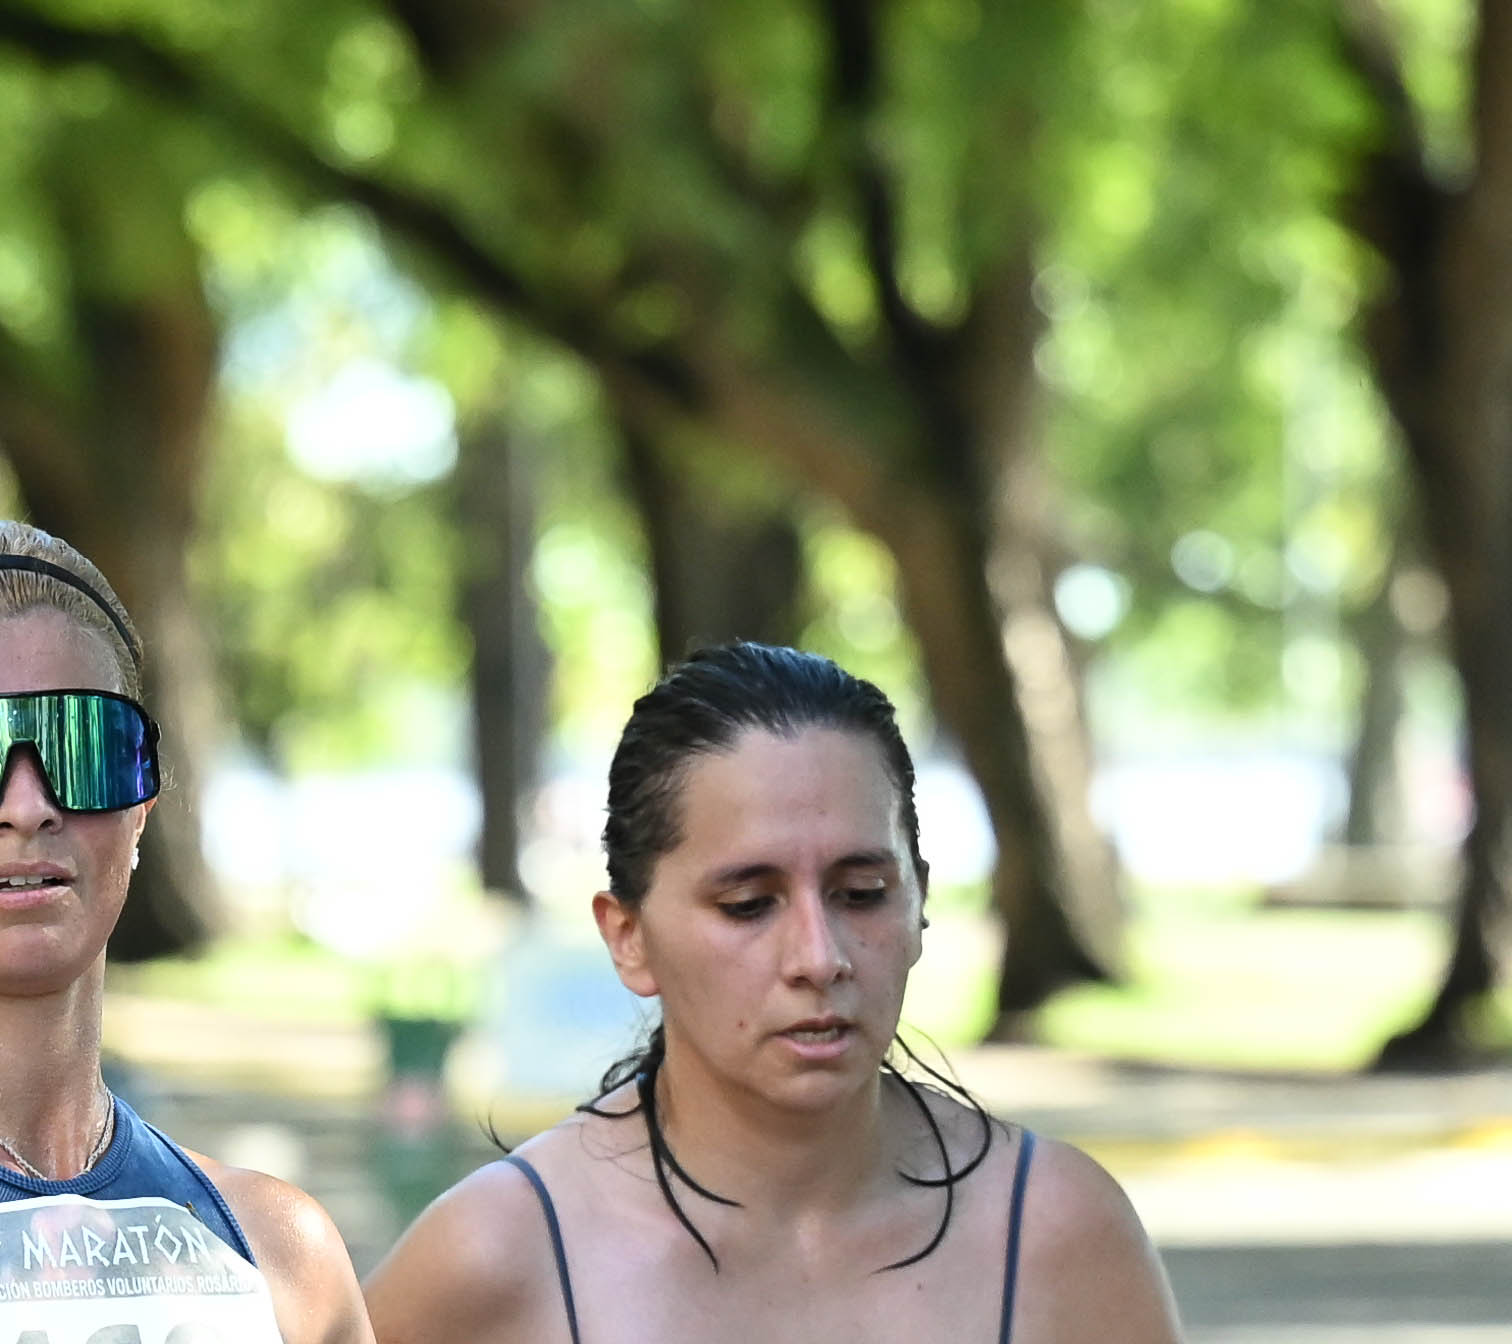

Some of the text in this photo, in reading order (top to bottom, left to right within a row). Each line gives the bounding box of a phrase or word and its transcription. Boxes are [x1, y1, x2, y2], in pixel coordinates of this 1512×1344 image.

[22, 1214, 209, 1271] MARATÓN
[32, 1277, 106, 1299] BOMBEROS
[107, 1273, 197, 1298] VOLUNTARIOS
